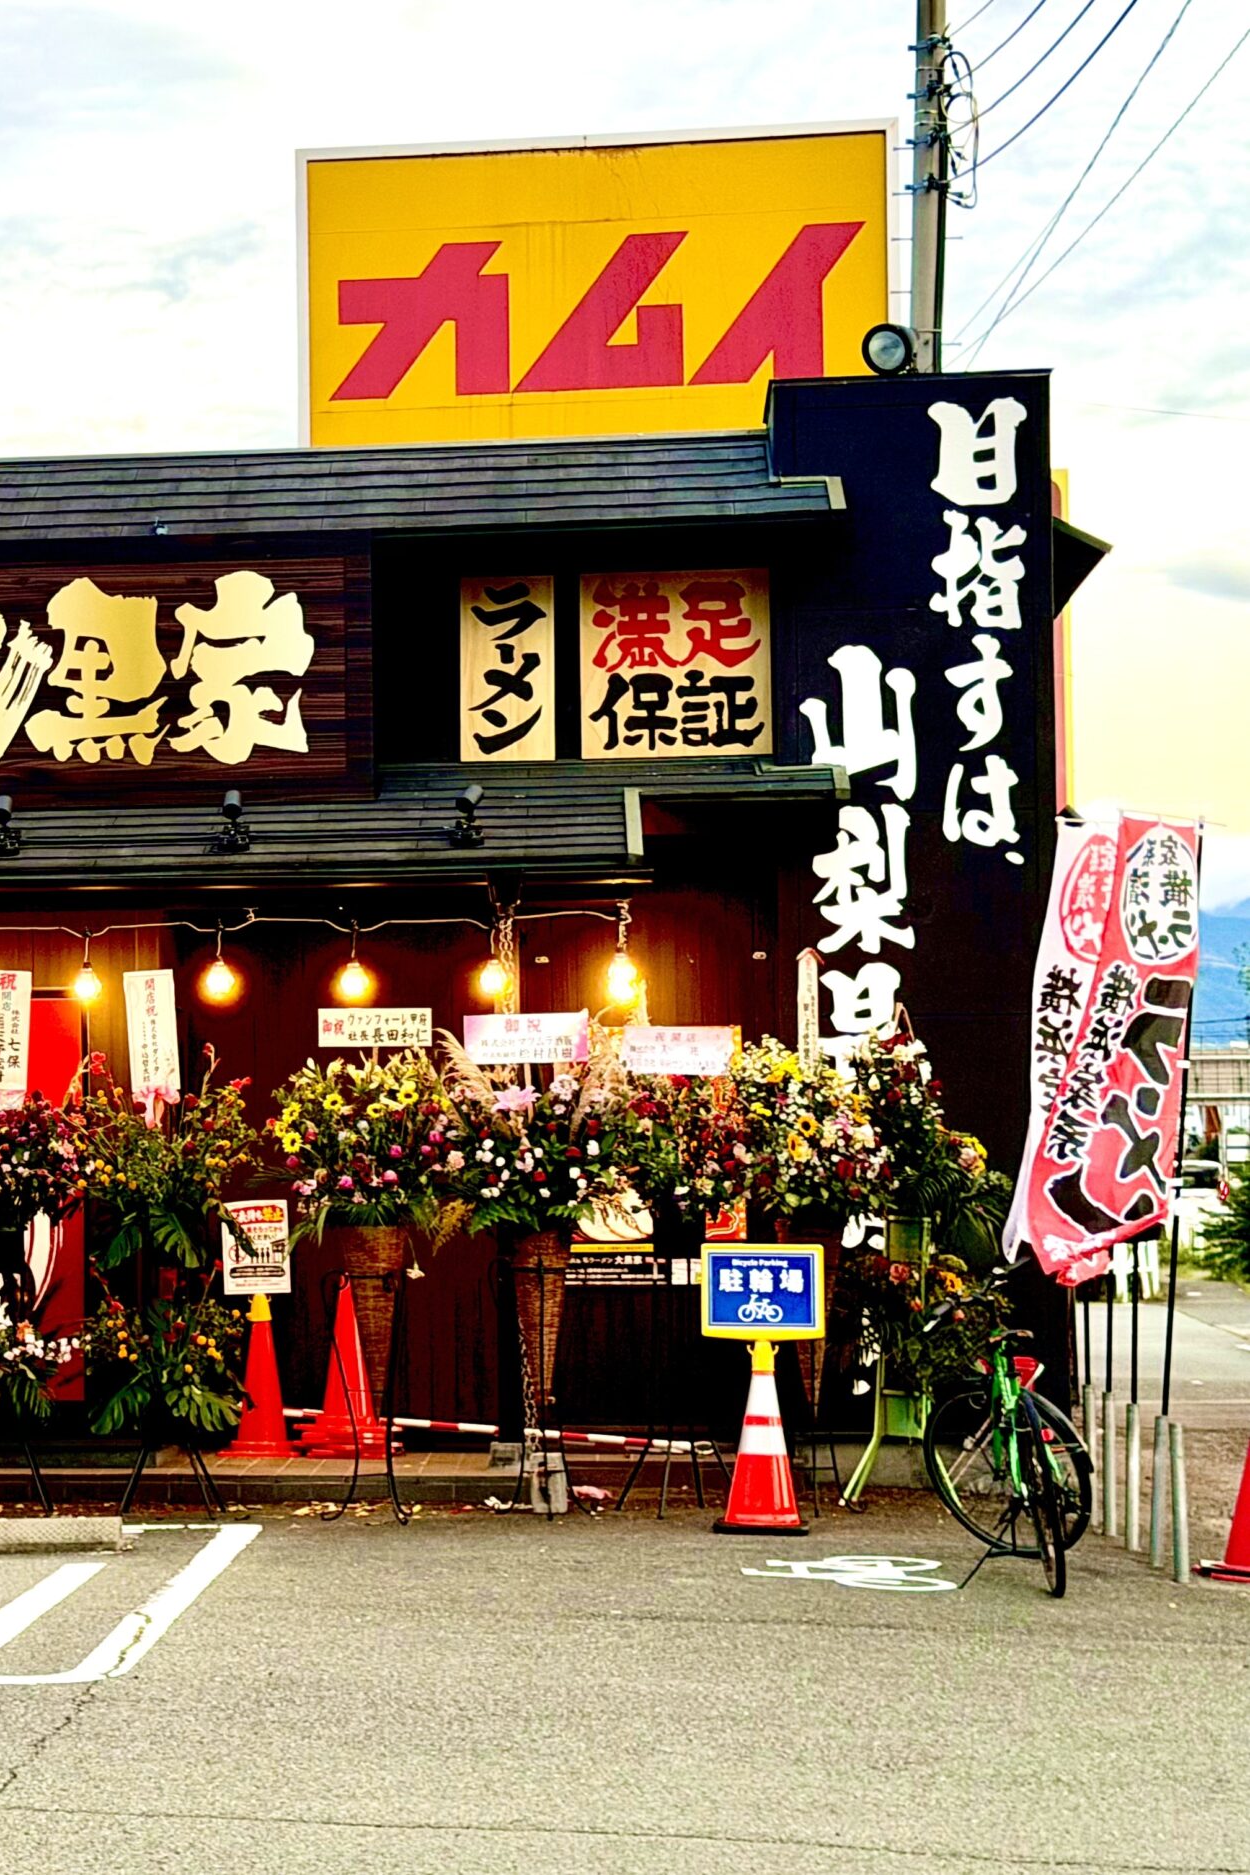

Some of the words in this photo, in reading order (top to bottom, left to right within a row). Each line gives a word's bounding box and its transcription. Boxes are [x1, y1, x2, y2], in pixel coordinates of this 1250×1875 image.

[330, 221, 866, 401] カムイ
[469, 582, 548, 754] ラーメン
[591, 580, 763, 674] 満足
[589, 669, 765, 752] 保証
[719, 1268, 804, 1293] 駐輪場
